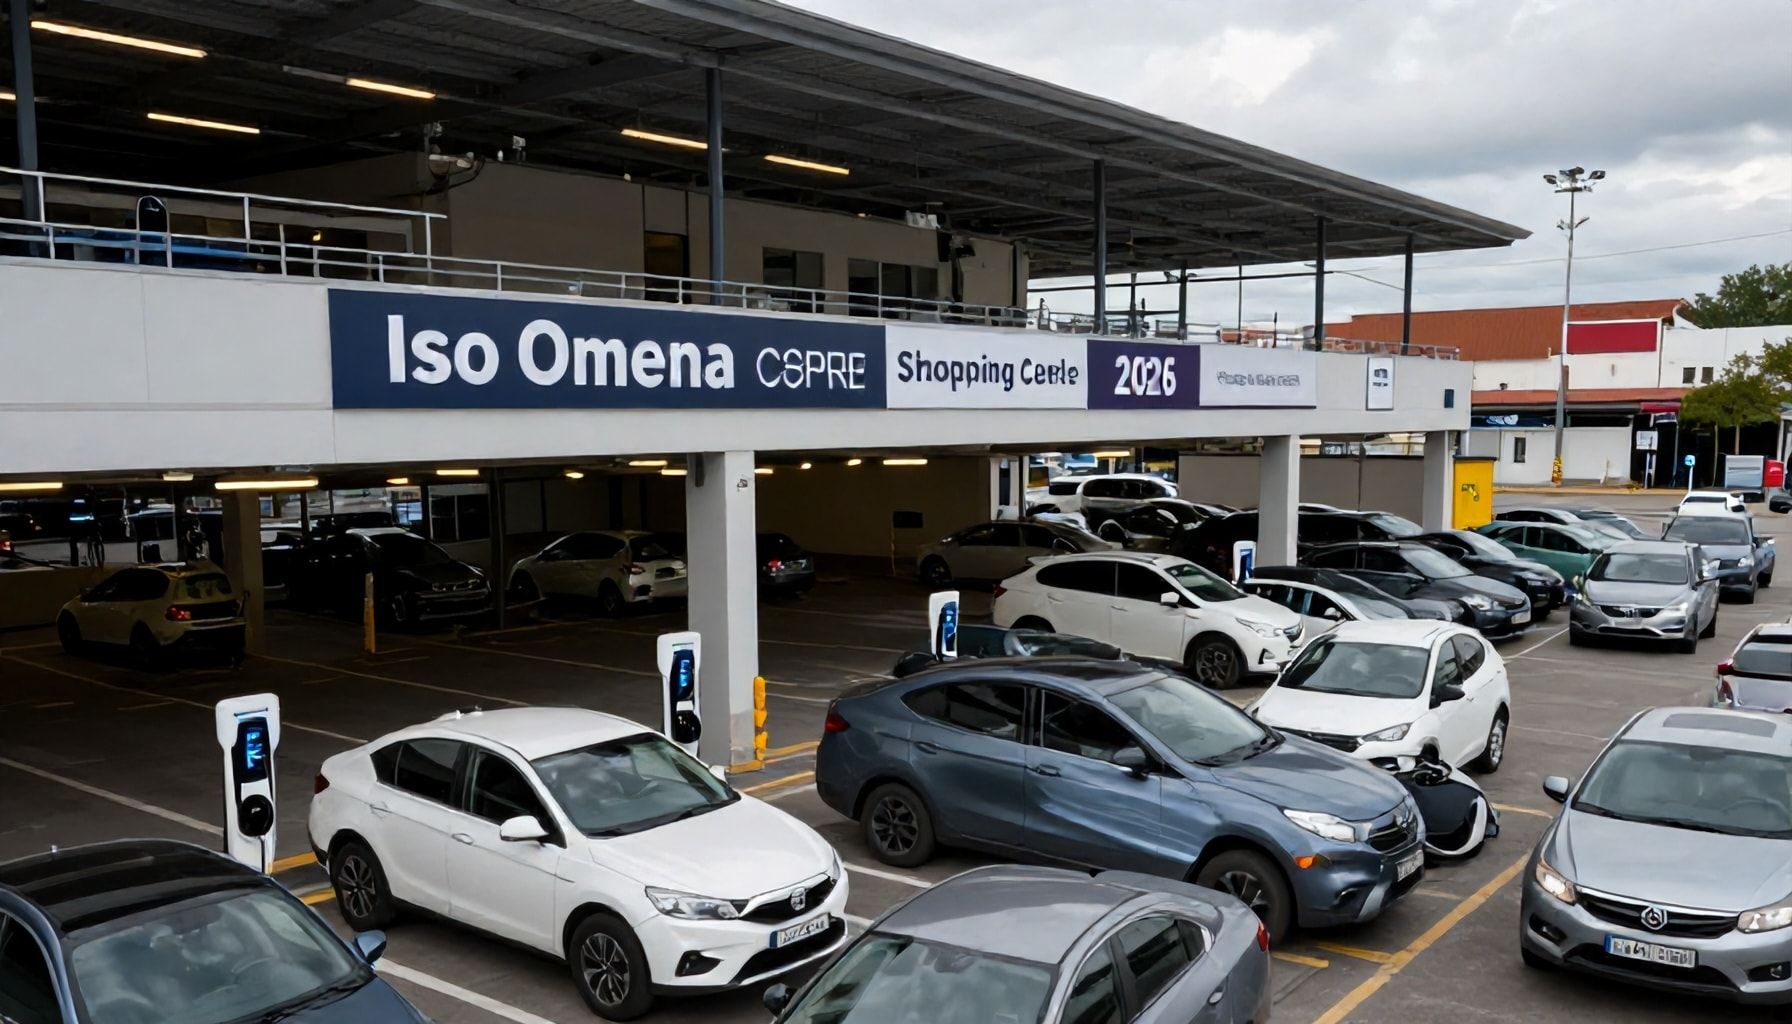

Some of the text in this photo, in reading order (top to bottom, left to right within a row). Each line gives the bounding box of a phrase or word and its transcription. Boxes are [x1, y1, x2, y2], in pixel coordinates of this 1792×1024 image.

[387, 314, 500, 386] Iso
[517, 319, 735, 388] Omena
[897, 350, 1014, 392] Shopping
[1114, 355, 1177, 396] 2026
